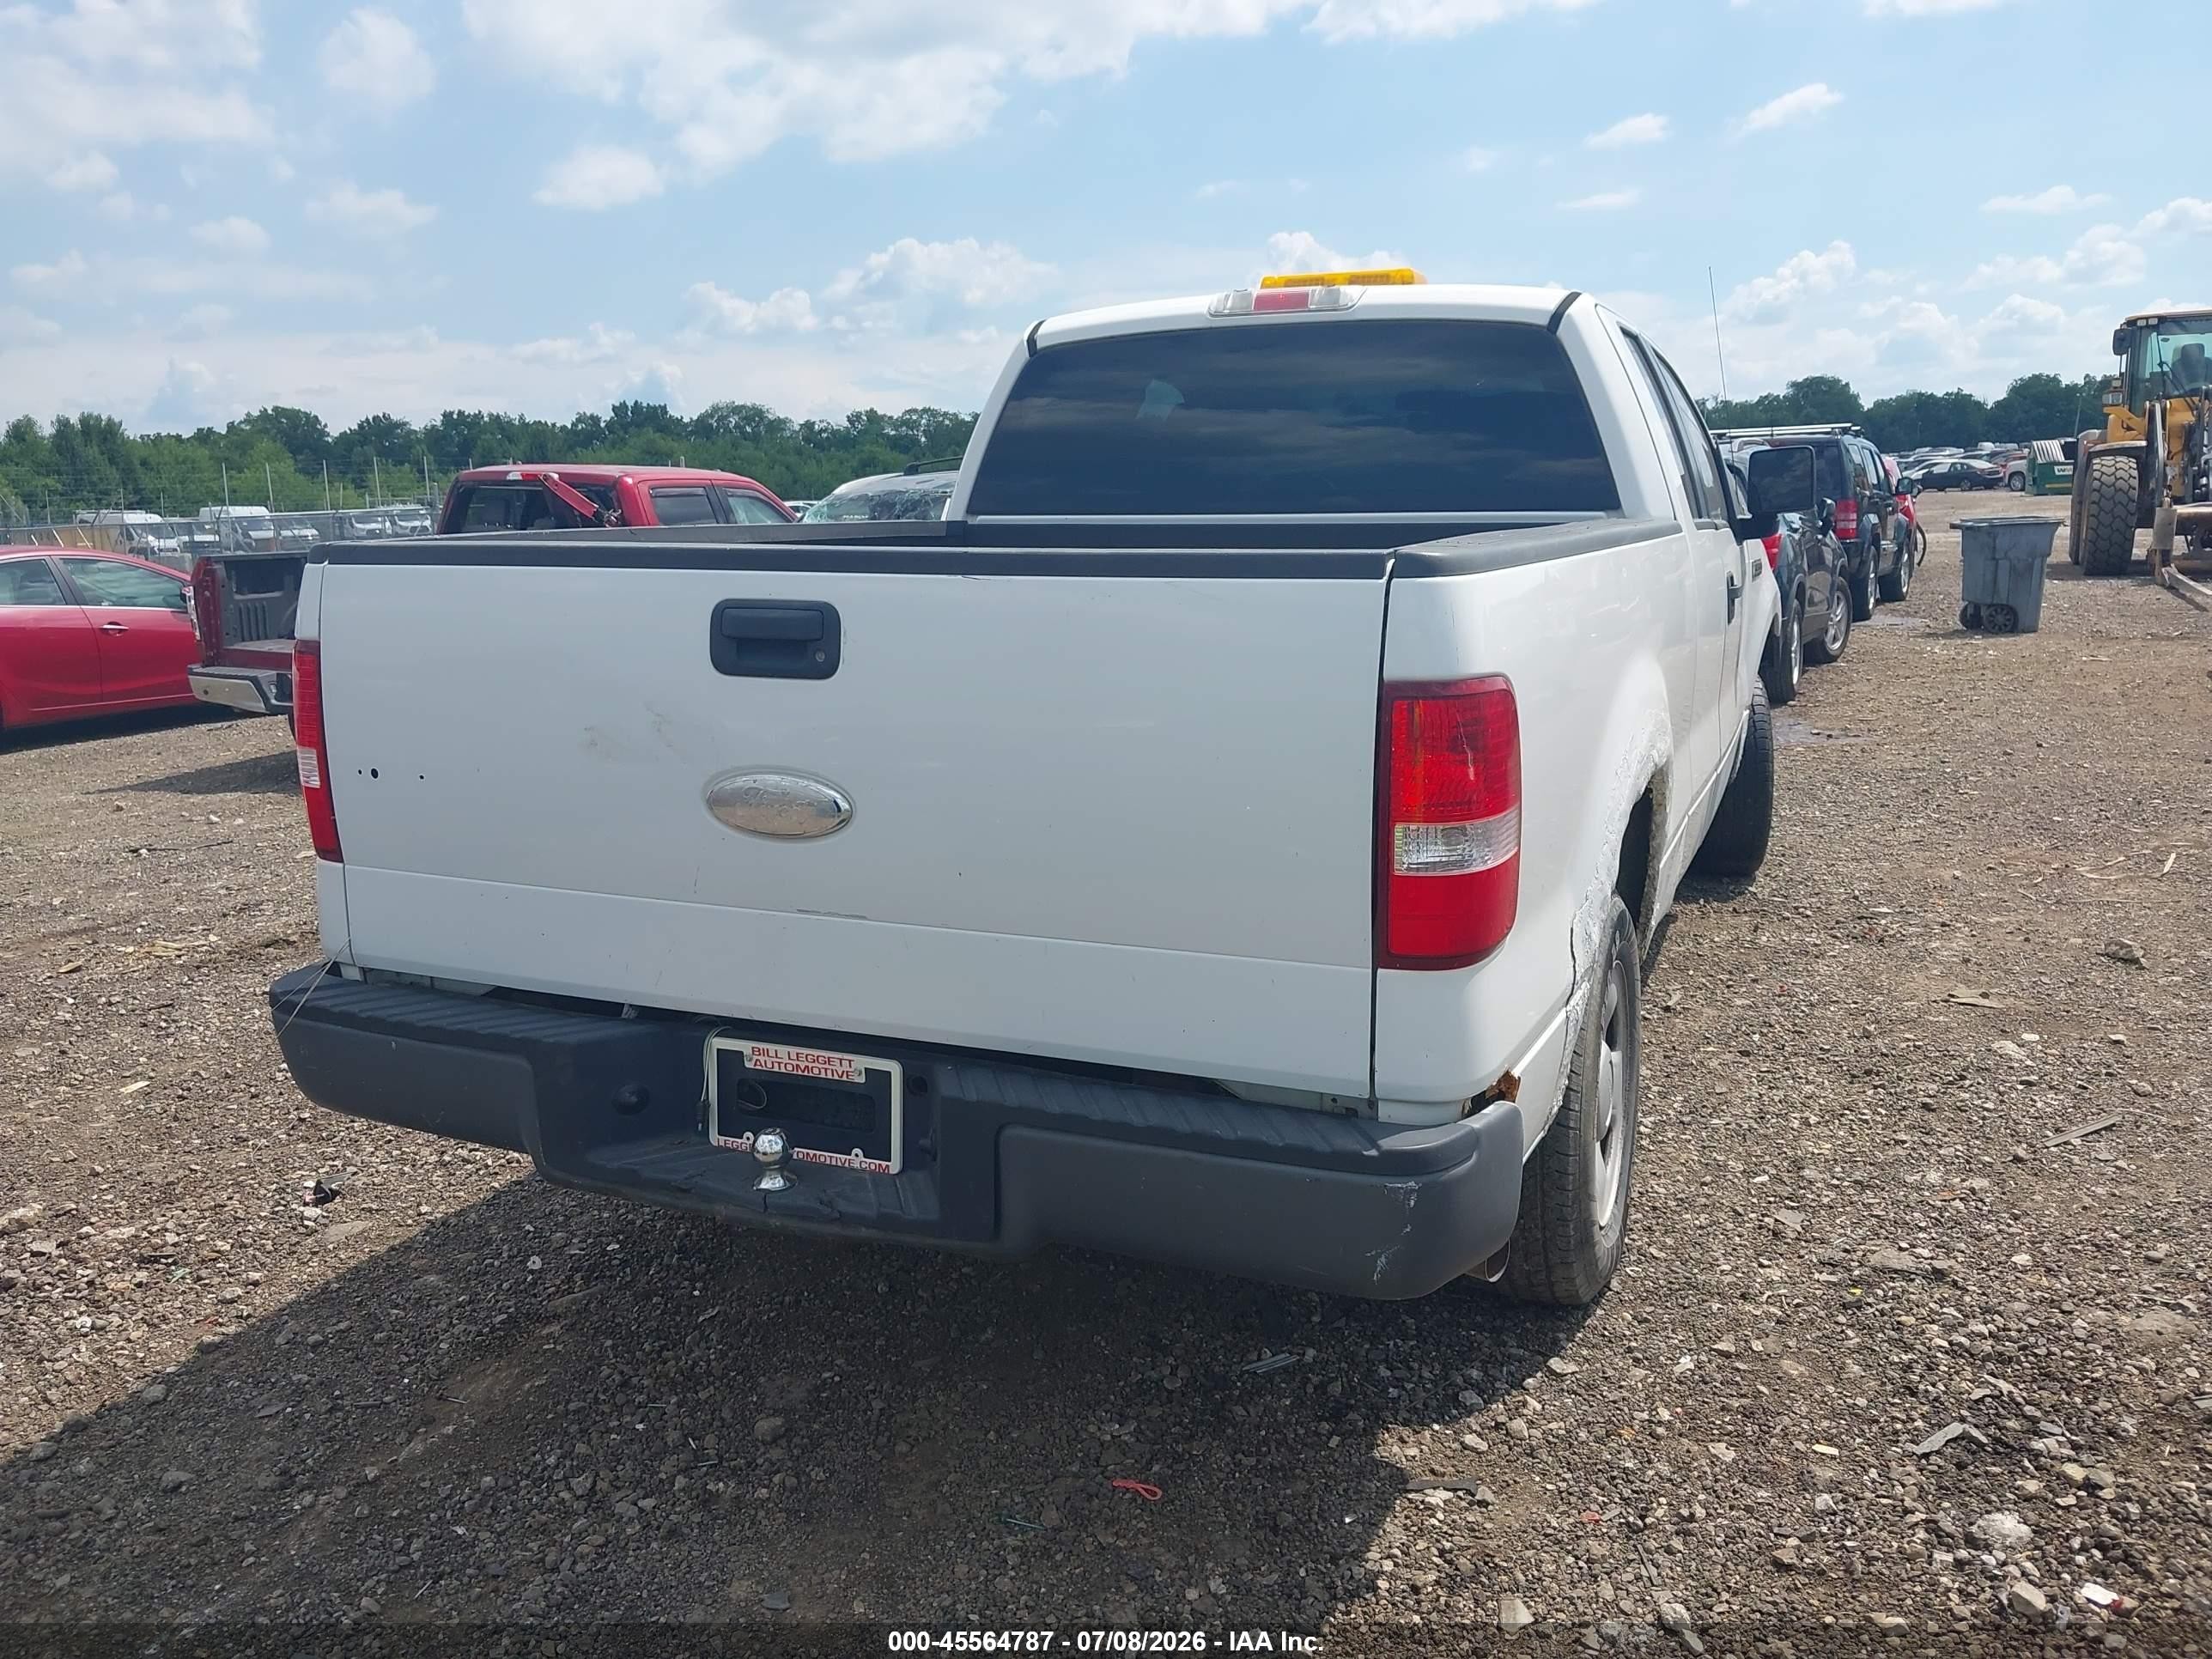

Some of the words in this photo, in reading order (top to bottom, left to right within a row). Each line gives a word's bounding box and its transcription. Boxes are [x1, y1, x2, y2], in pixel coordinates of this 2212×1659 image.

[751, 1047, 783, 1060] BILL
[787, 1051, 854, 1068] LEGGETT
[753, 1059, 854, 1080] AUTOMOTIVE
